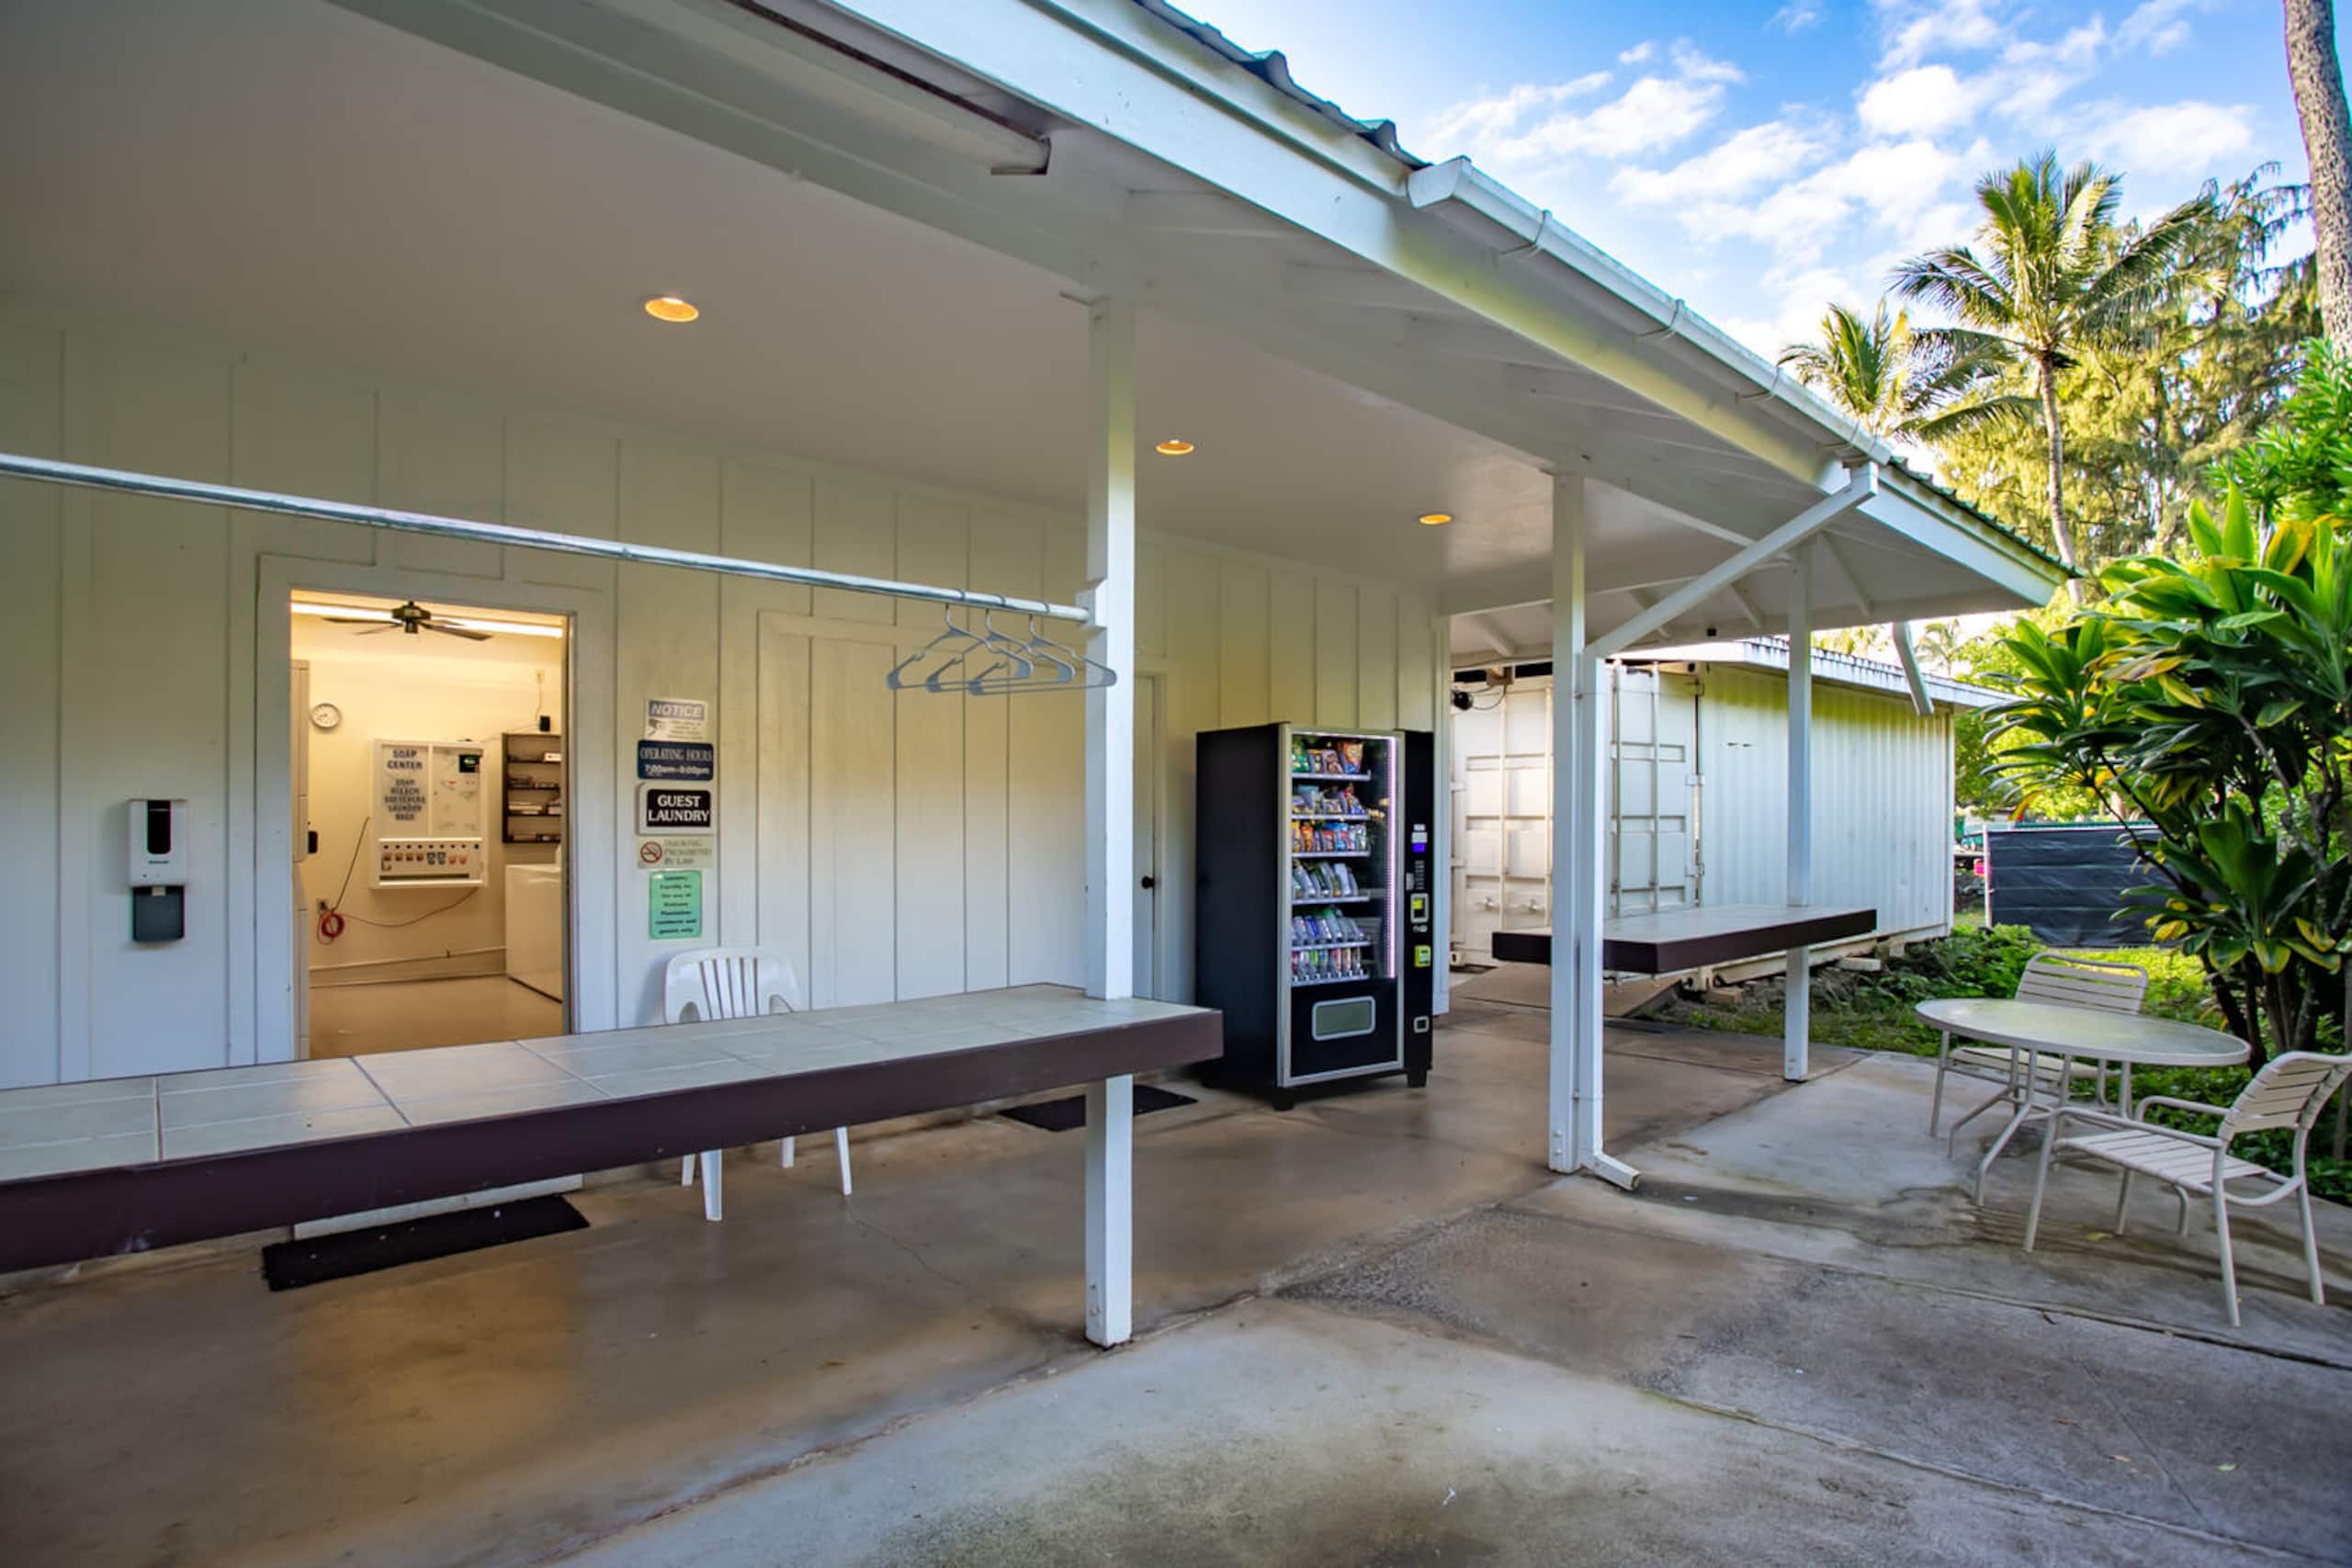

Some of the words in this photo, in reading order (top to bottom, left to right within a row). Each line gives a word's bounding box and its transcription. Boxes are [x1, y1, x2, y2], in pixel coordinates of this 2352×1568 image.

[650, 703, 703, 718] NOTICE
[392, 749, 417, 758] SOAP
[639, 747, 684, 761] OPERATING
[685, 749, 713, 761] HOURS
[387, 760, 423, 770] CENTER
[657, 794, 702, 807] GUEST
[648, 809, 710, 822] LAUNDRY
